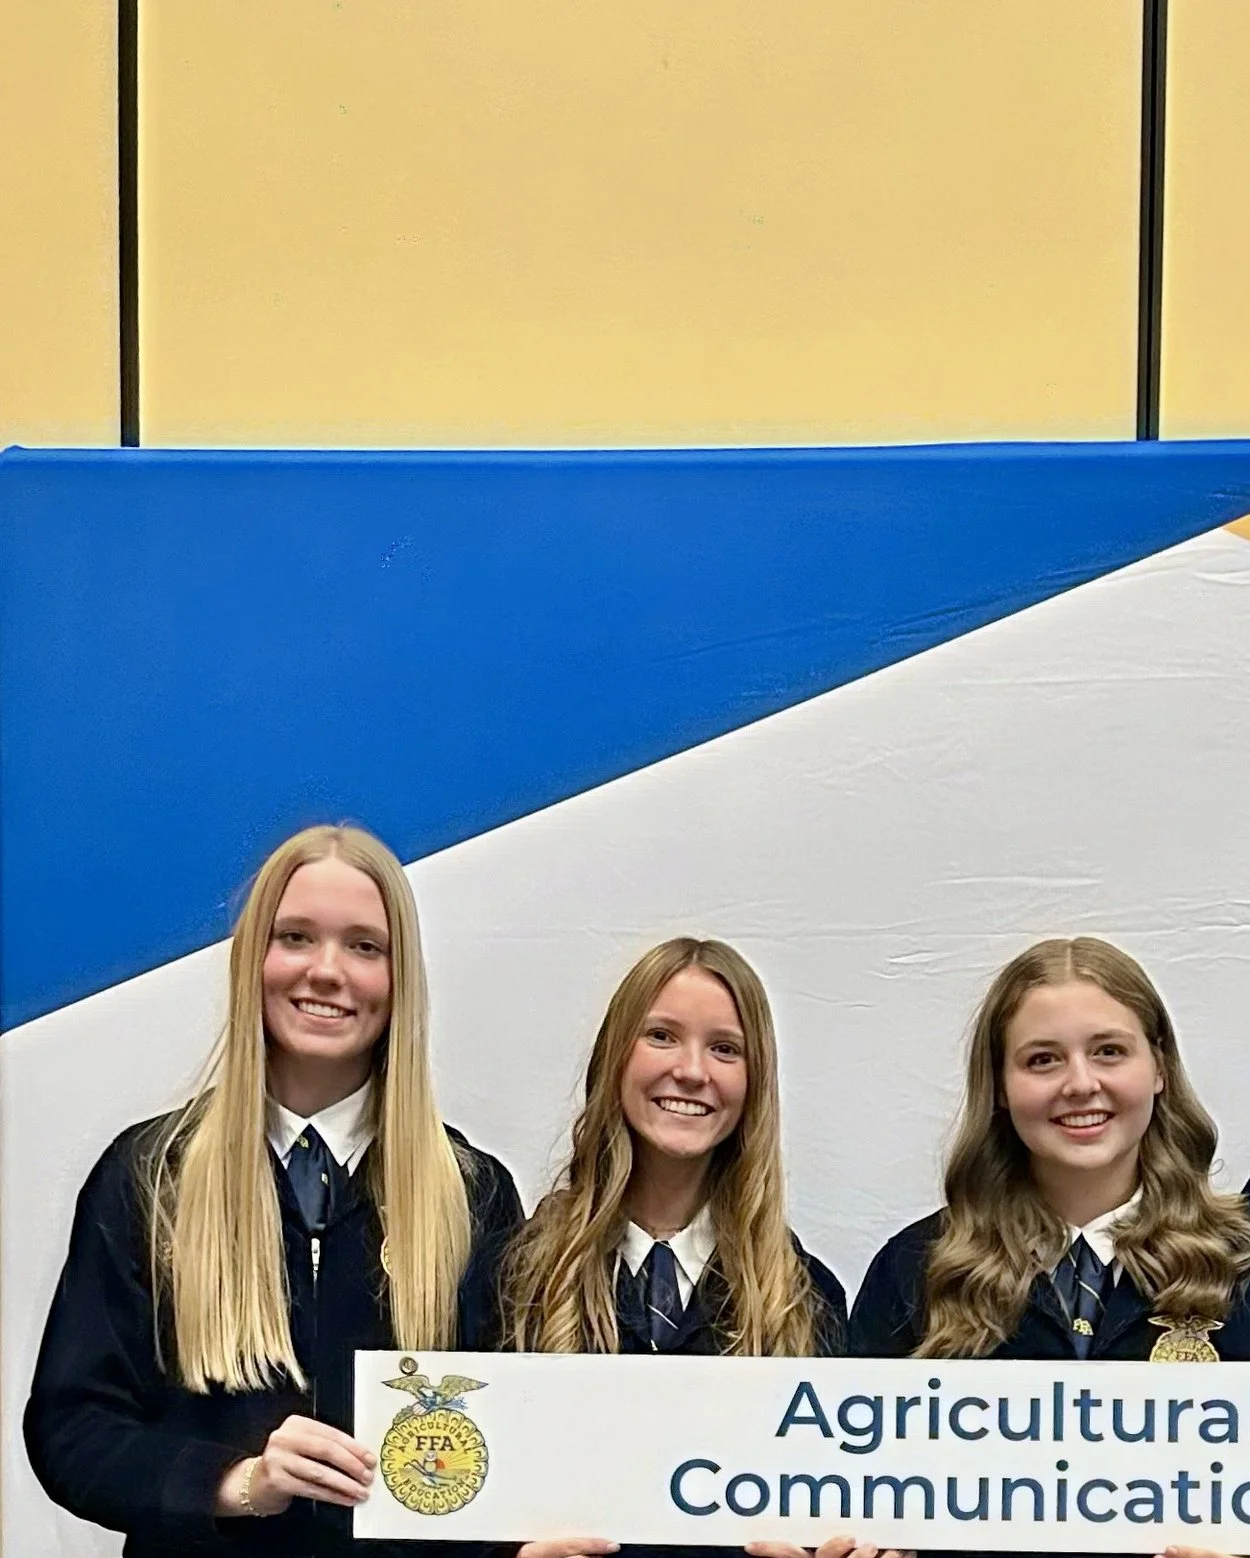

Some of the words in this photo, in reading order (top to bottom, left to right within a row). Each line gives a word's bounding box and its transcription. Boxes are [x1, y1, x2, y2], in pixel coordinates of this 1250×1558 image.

[397, 1421, 473, 1455] AGRICULTURAL
[416, 1436, 455, 1452] FFA
[402, 1477, 468, 1500] EDUCATION
